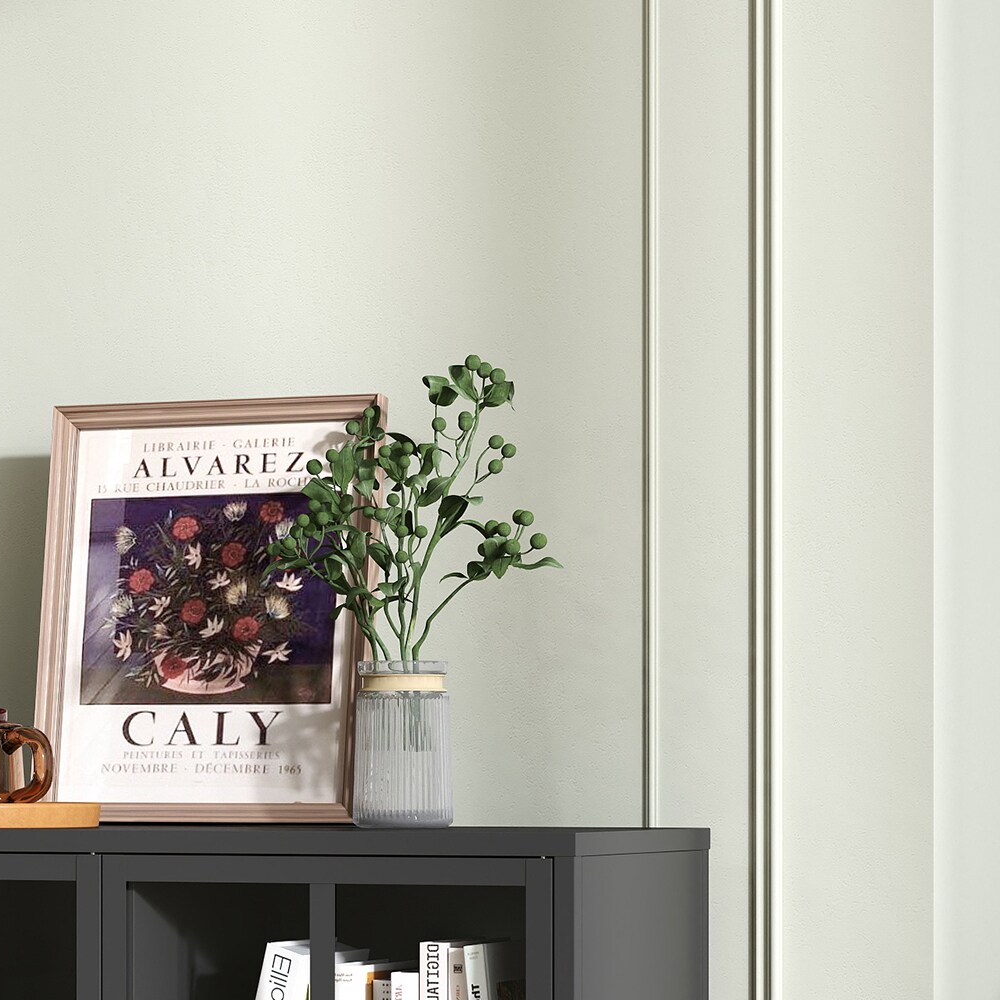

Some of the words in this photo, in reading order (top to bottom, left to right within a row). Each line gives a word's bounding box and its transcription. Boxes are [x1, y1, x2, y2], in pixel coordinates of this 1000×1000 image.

[144, 440, 215, 453] LIBRAIRIE
[233, 437, 295, 449] GALERIE
[132, 452, 304, 478] ALVAREZ
[115, 483, 140, 493] RUE
[146, 480, 226, 492] CHAUDRIER
[245, 478, 260, 488] LA
[122, 710, 283, 747] CALY
[123, 751, 183, 759] PEINTURES
[191, 751, 203, 759] ET
[214, 750, 280, 759] TAPISSERIES
[101, 763, 177, 774] NOVEMBRE
[195, 762, 269, 774] DÉCEMBRE
[278, 765, 301, 774] 1965
